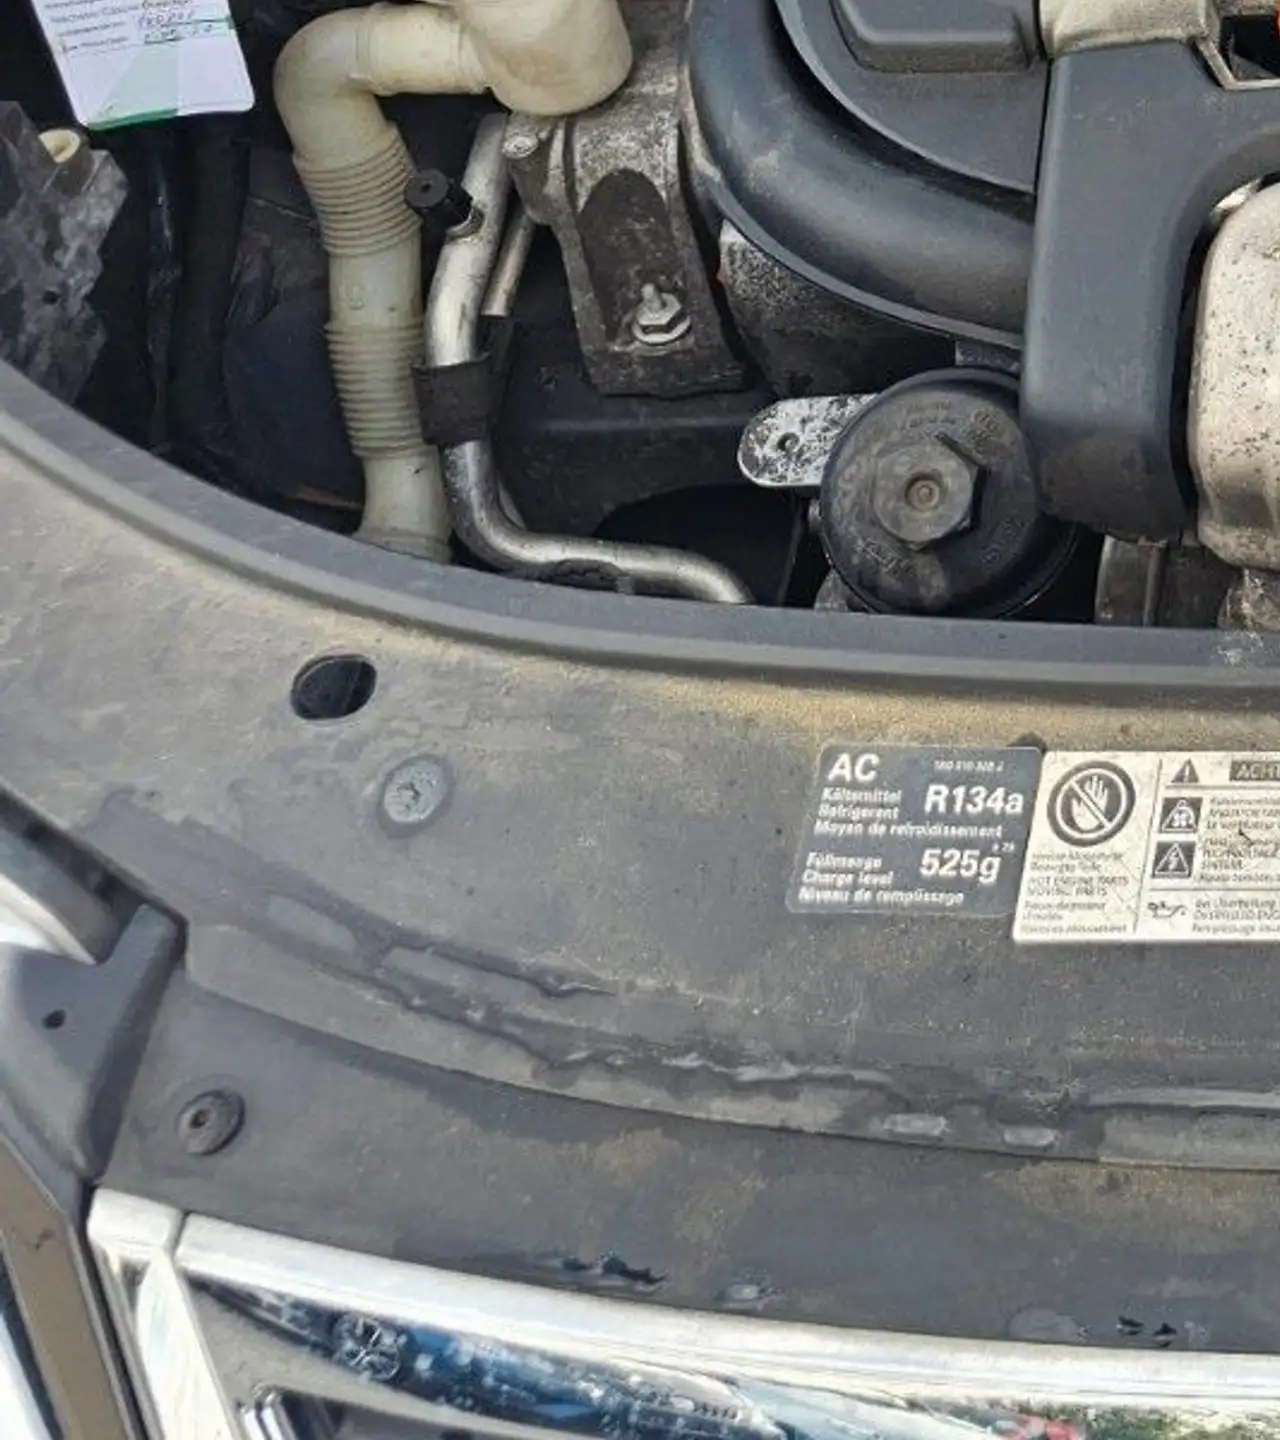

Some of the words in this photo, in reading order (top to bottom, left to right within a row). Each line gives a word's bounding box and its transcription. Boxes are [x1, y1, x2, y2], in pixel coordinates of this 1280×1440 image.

[827, 753, 880, 783] AC
[922, 784, 1024, 815] R134a
[813, 819, 863, 838] Moyen
[868, 821, 886, 837] de
[802, 869, 853, 888] Charge
[858, 870, 894, 885] level
[919, 848, 1002, 887] 525g
[853, 887, 873, 903] de
